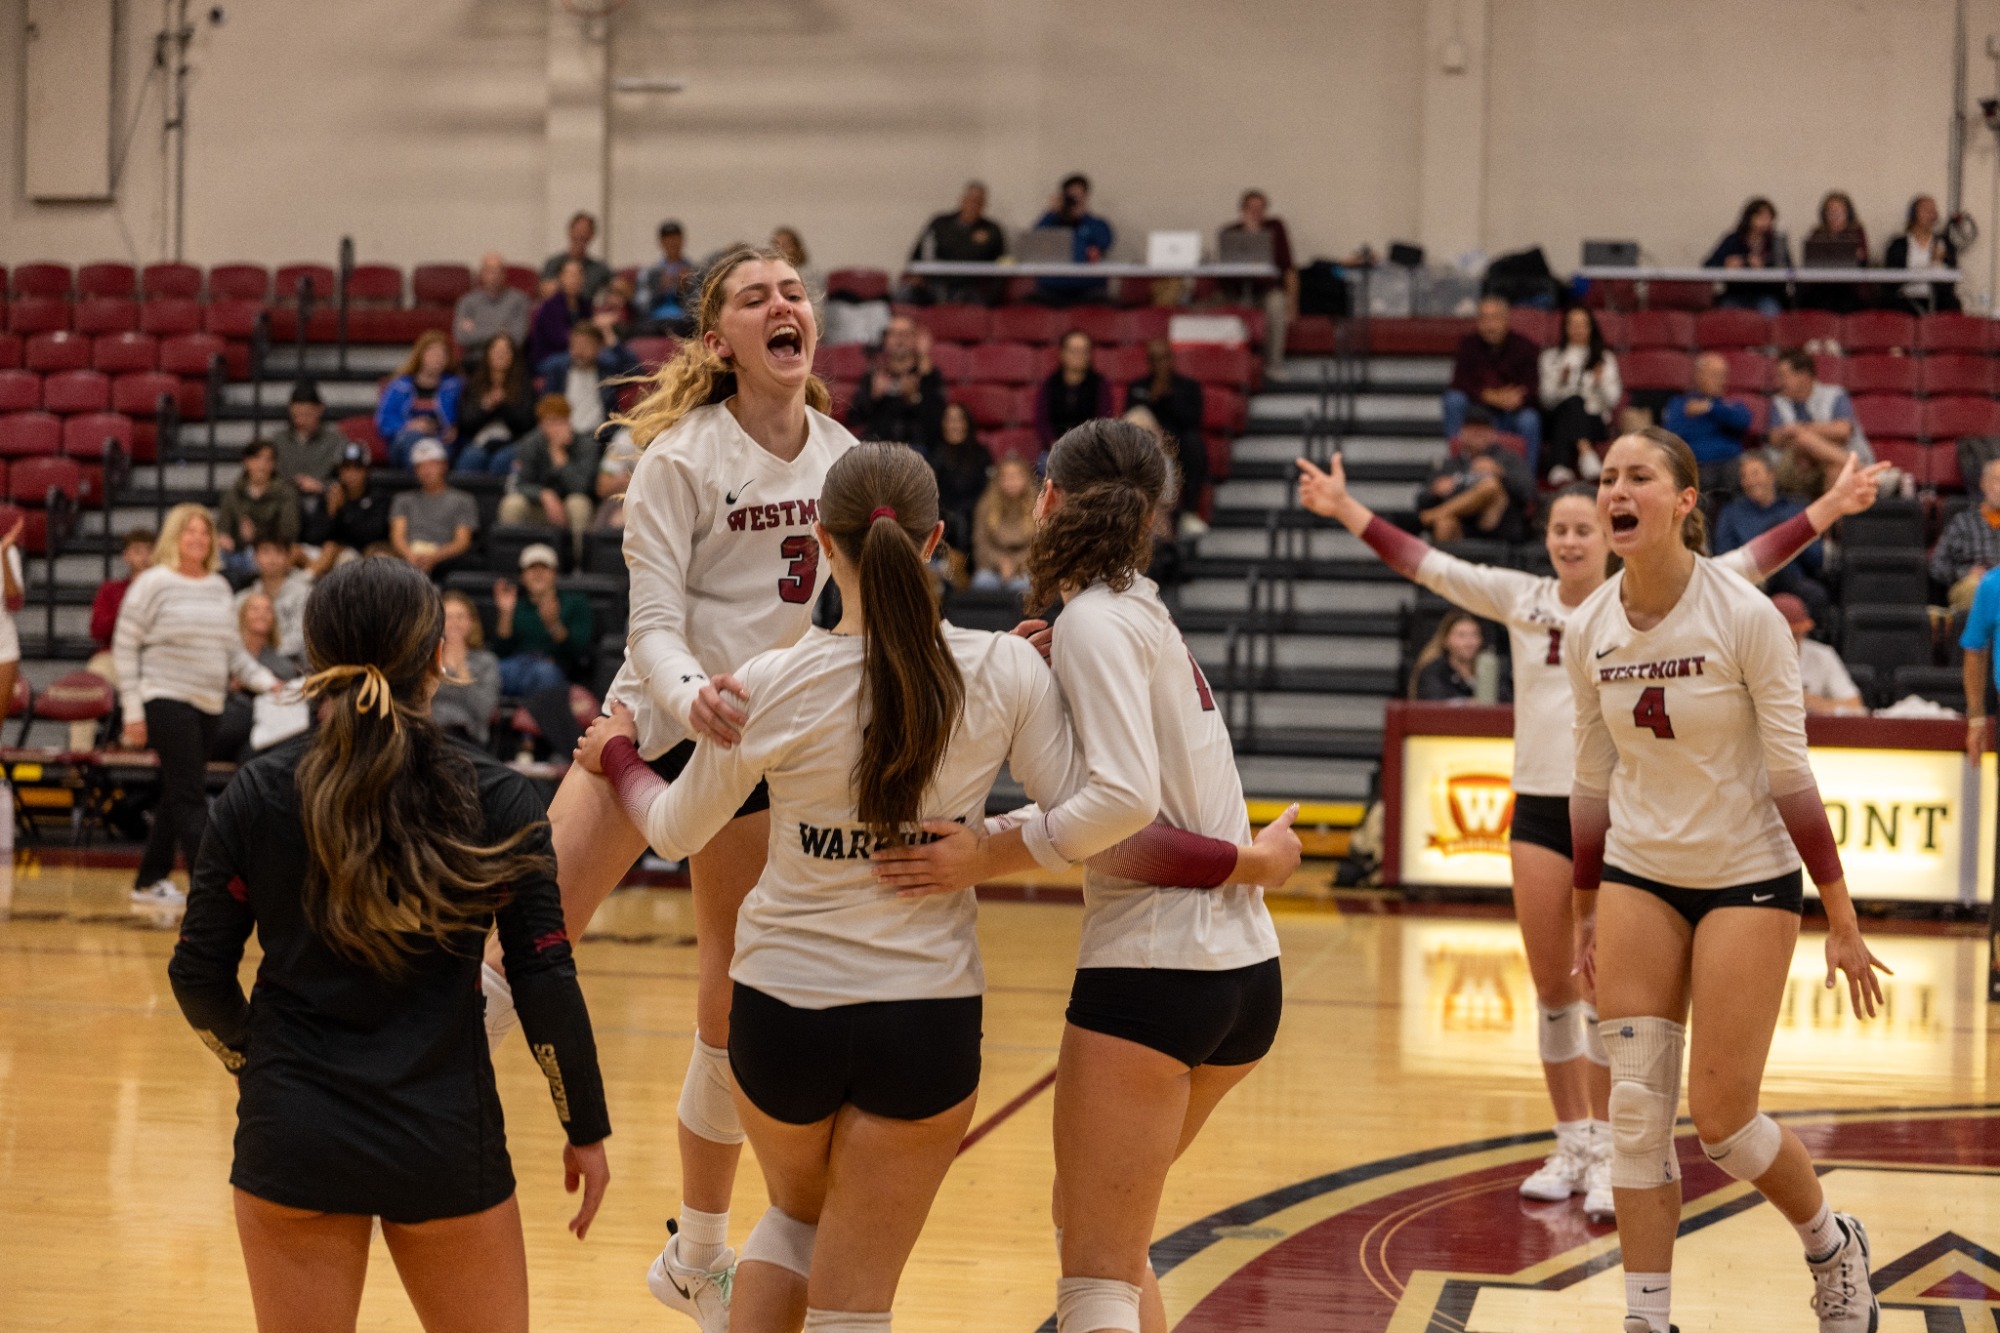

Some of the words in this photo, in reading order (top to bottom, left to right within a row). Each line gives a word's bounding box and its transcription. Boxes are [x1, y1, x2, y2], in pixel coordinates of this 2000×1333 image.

[727, 498, 820, 532] WESTM
[778, 534, 819, 604] 3
[1600, 655, 1706, 682] WESTMONT
[1633, 686, 1675, 739] 4
